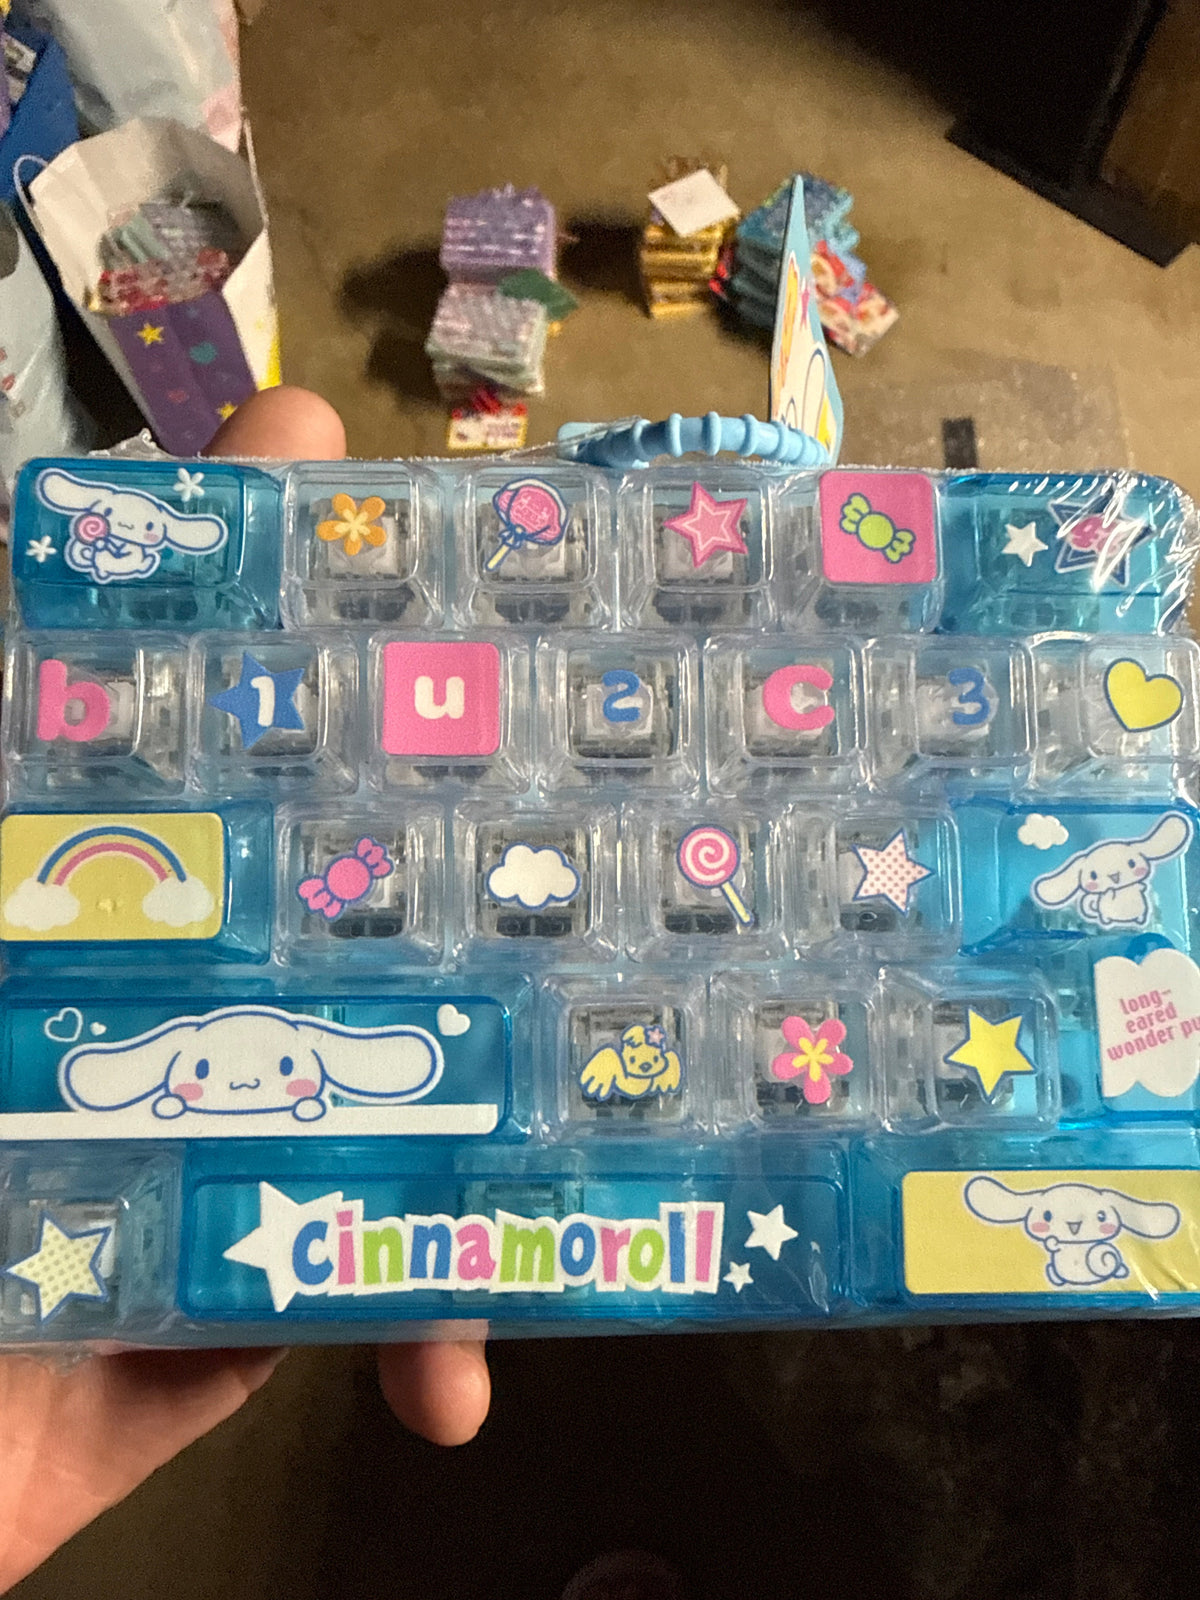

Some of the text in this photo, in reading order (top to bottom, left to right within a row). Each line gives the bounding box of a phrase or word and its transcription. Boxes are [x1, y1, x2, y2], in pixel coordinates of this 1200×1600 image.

[36, 659, 111, 742] b
[251, 676, 275, 727] 1
[414, 675, 465, 719] u
[602, 670, 640, 723] 2
[948, 667, 989, 725] 3
[1119, 989, 1172, 1015] long-
[1125, 1001, 1177, 1034] eared
[1107, 1026, 1175, 1061] wonder
